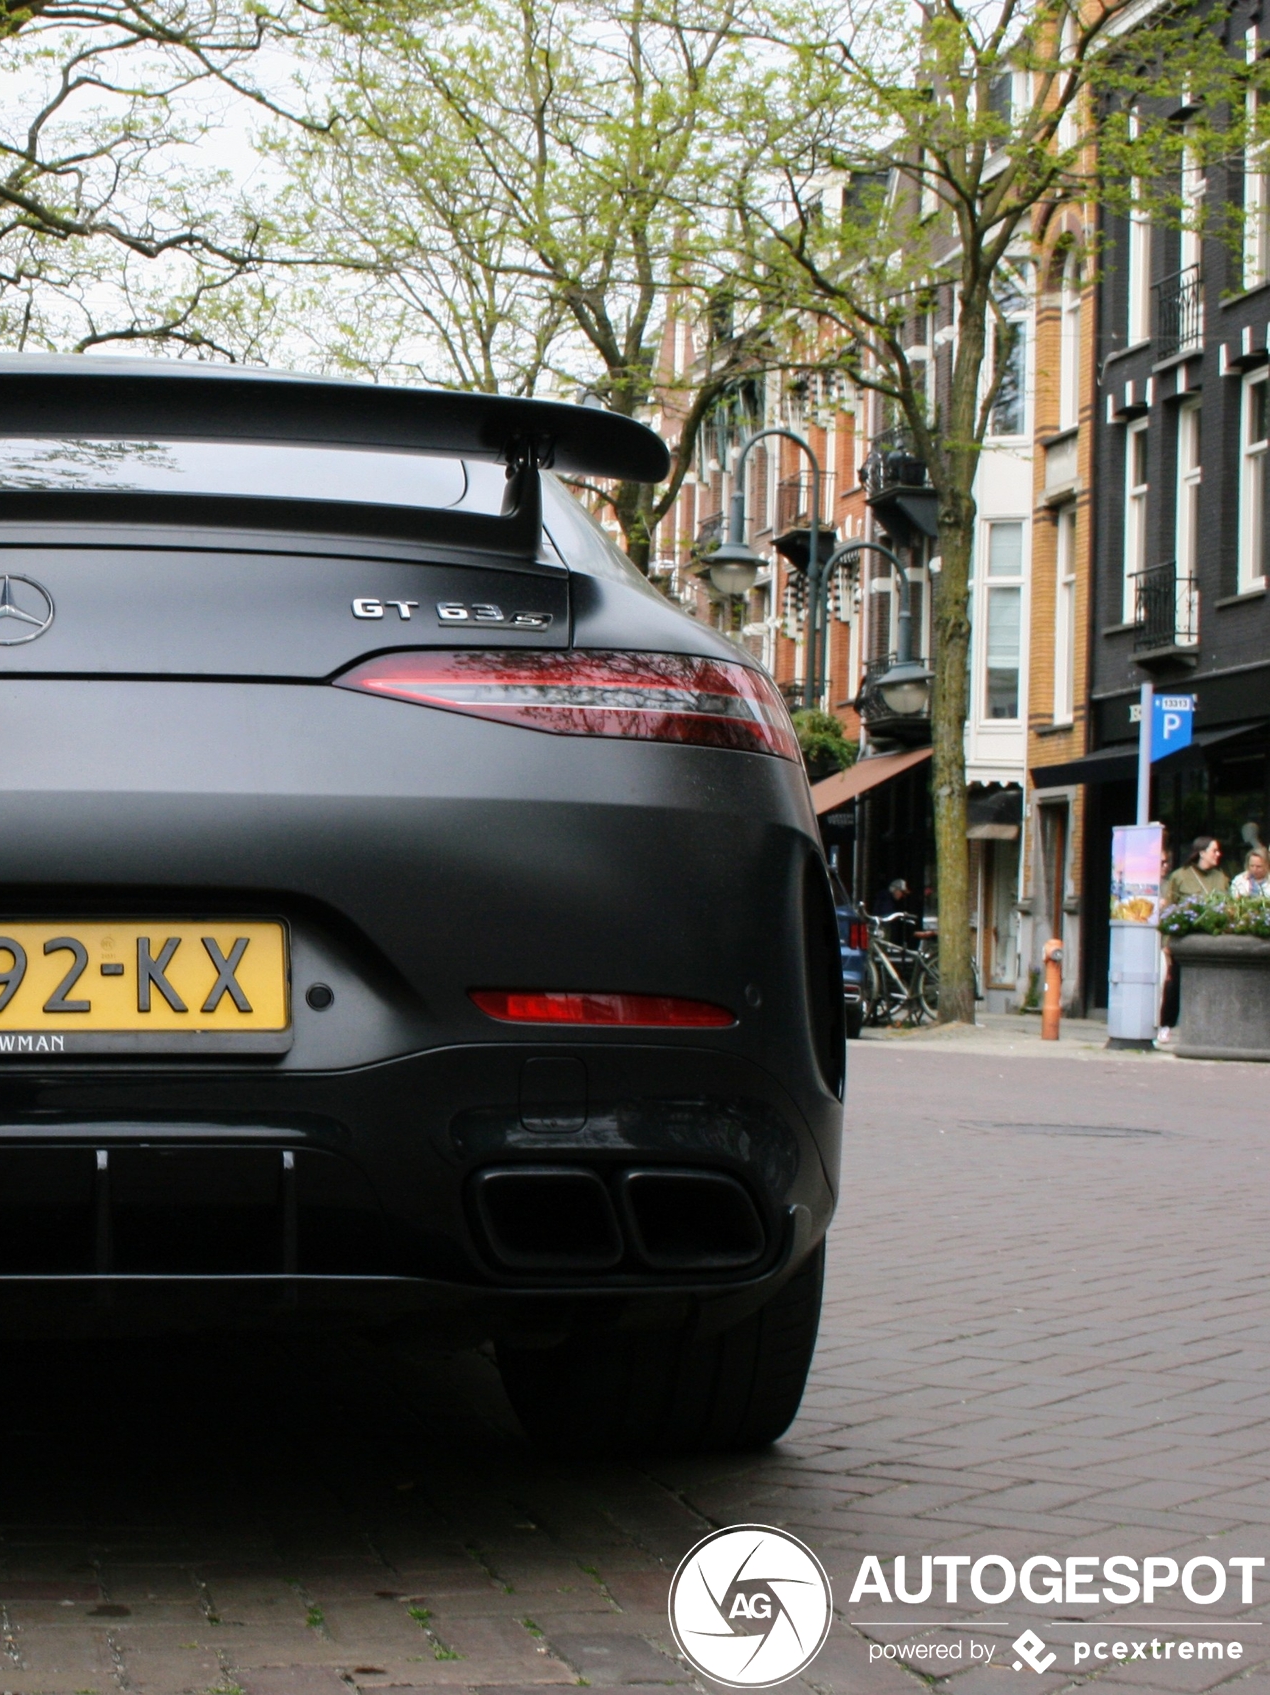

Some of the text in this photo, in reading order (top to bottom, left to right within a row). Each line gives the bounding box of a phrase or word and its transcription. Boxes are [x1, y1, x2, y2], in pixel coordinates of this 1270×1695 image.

[352, 599, 420, 620] GT
[436, 602, 505, 621] 63
[1164, 699, 1187, 708] 13313
[1163, 713, 1180, 739] P
